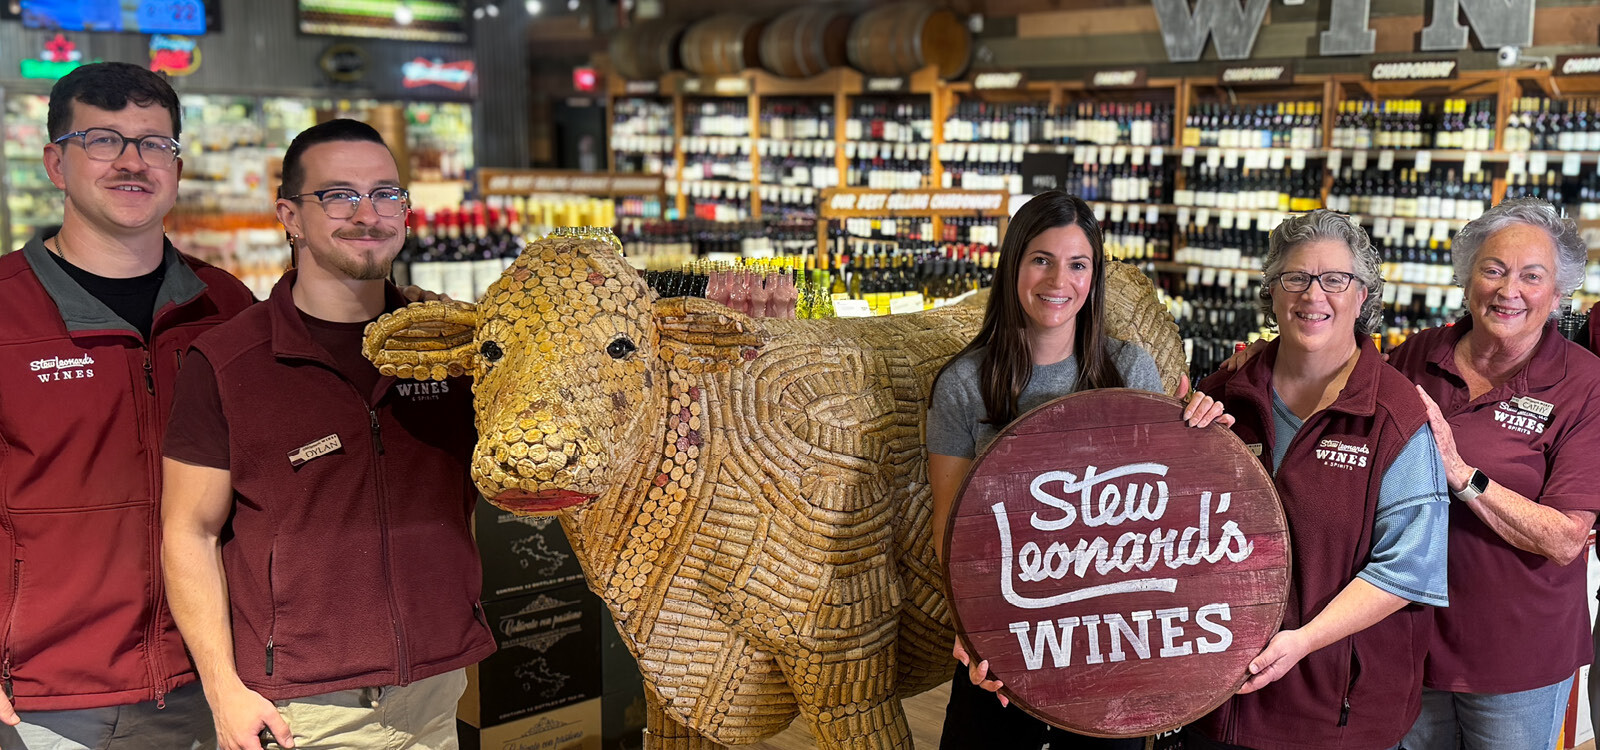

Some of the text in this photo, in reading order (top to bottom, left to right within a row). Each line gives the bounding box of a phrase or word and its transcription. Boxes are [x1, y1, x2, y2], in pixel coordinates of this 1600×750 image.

[37, 369, 95, 383] WINES
[396, 381, 449, 397] WINES
[1523, 402, 1549, 414] CATHY
[1494, 410, 1545, 434] WINES
[1508, 425, 1531, 435] SPIRITS
[305, 440, 338, 457] DYLAN
[1316, 449, 1368, 468] WINES
[1330, 462, 1353, 471] SPIRITS
[1030, 462, 1170, 531] Stew
[991, 491, 1255, 609] Leonard's
[1009, 602, 1234, 671] WINES
